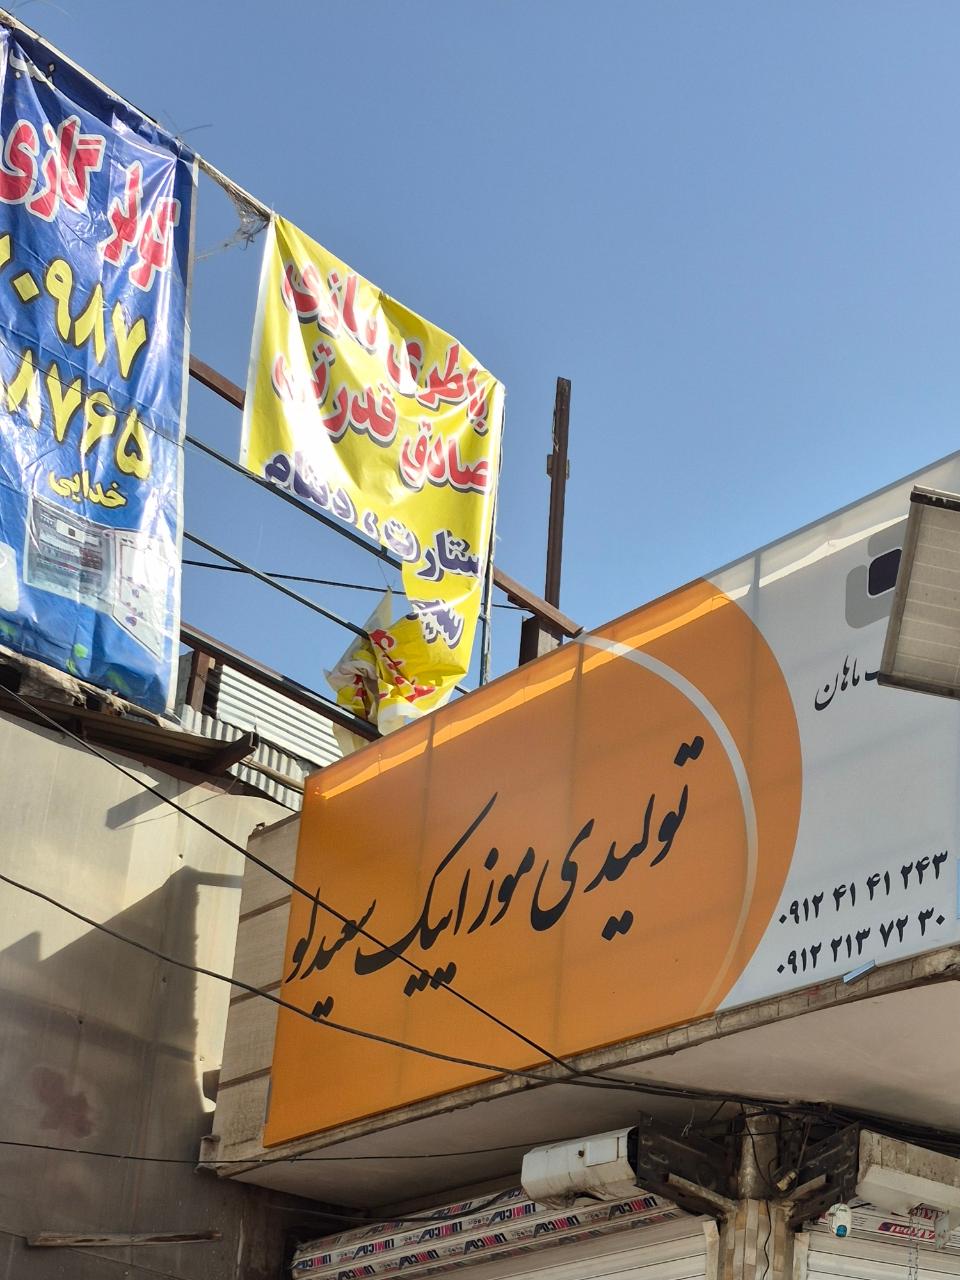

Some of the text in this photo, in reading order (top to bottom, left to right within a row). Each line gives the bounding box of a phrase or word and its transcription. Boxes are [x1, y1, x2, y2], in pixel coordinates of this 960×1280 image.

[0, 115, 107, 223] گازی
[0, 233, 148, 380] ۰۹۸۷
[387, 342, 488, 432] باطری
[48, 470, 127, 508] خدایی
[401, 420, 491, 493] صادق
[814, 655, 861, 712] ماهان
[284, 735, 705, 1020] تولیدی موزاییک سعیدلو
[778, 891, 824, 925] ۰۹۱۲
[900, 850, 948, 890] ۲۴۳
[776, 907, 946, 975] ۰۹۱۲ ۲۱۳ ۷۲ ۳۰
[890, 1223, 937, 1241] Akpal
